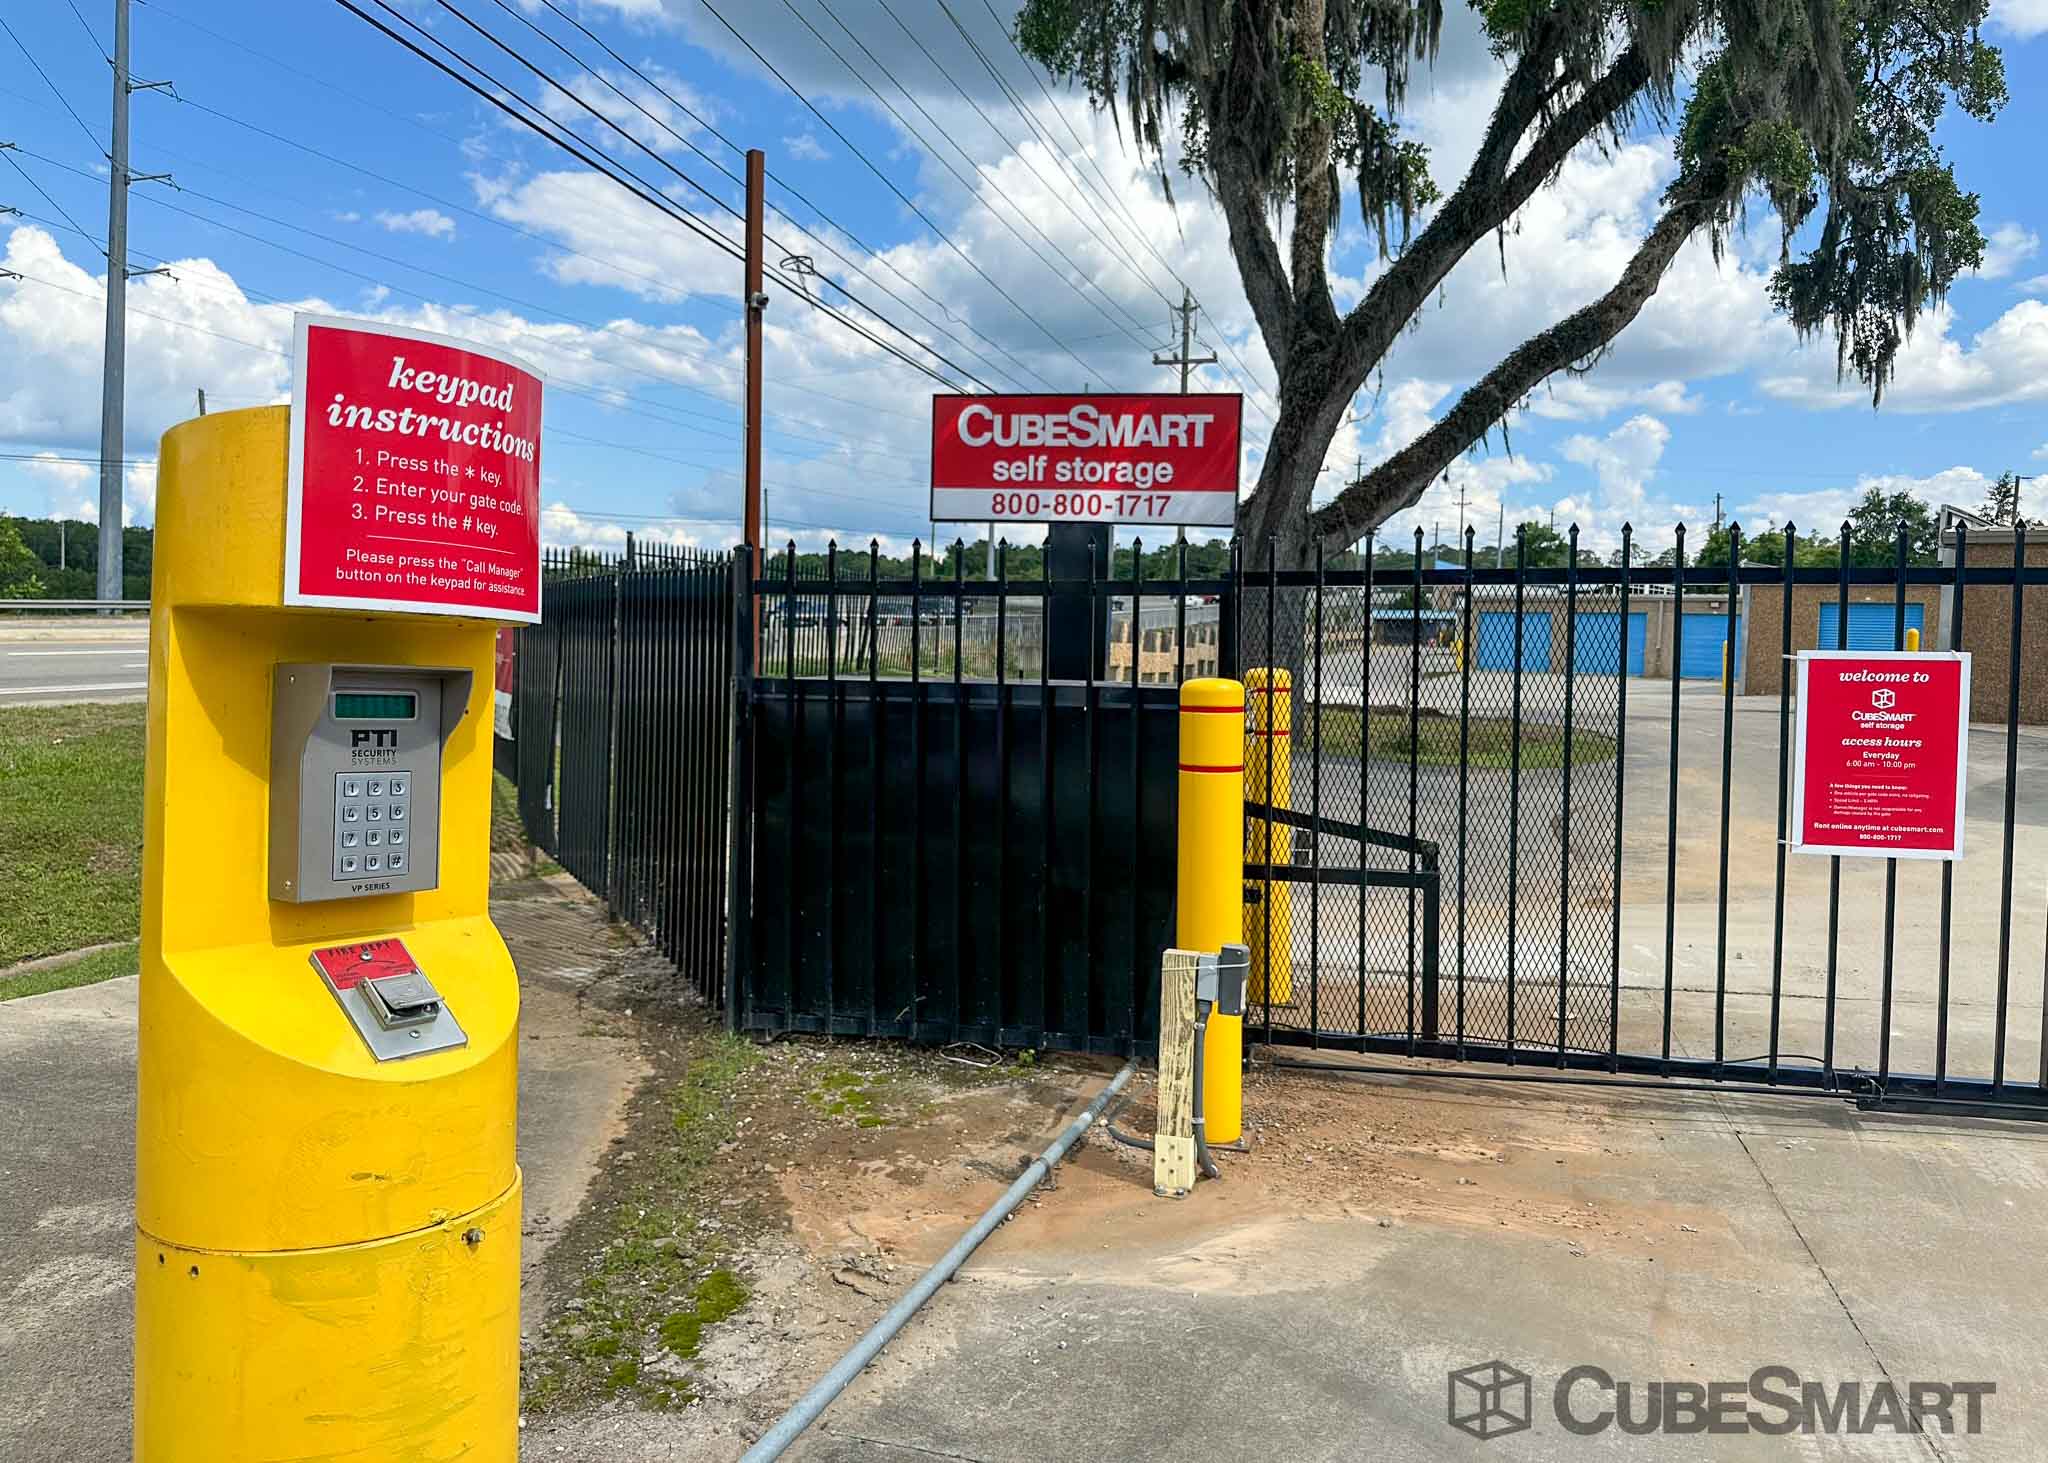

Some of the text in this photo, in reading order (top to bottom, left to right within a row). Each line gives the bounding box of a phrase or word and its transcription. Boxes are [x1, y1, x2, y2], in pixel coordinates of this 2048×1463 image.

[388, 356, 514, 413] keypad
[327, 394, 535, 463] instructions
[356, 448, 370, 465] 1.
[378, 451, 428, 472] Press
[434, 459, 459, 476] the
[481, 468, 502, 486] key.
[993, 455, 1174, 488] self storage
[353, 477, 524, 516] 2. Enter your gate code.
[992, 494, 1171, 517] 800-800-1717
[352, 504, 367, 520] 3.
[376, 506, 426, 525] Press
[432, 512, 457, 529] the
[477, 518, 498, 537] key.
[346, 549, 394, 565] Please
[399, 555, 434, 568] press
[439, 558, 458, 570] the
[336, 567, 526, 596] button on the keypad for assistance.
[1840, 670, 1930, 683] welcome to
[1876, 722, 1905, 730] storage
[352, 729, 398, 748] PTI
[1842, 737, 1922, 748] access hours
[352, 749, 397, 758] SECURITY
[1863, 751, 1899, 760] Everyday
[352, 757, 397, 766] SYSTEMS
[1846, 760, 1862, 768] 6:00
[1883, 761, 1902, 769] 10:00
[1904, 762, 1916, 770] pm
[395, 783, 402, 793] 3
[372, 808, 379, 818] 5
[395, 806, 402, 816] 6
[371, 832, 378, 842] 8
[393, 831, 400, 841] 9
[364, 882, 390, 891] SERIES
